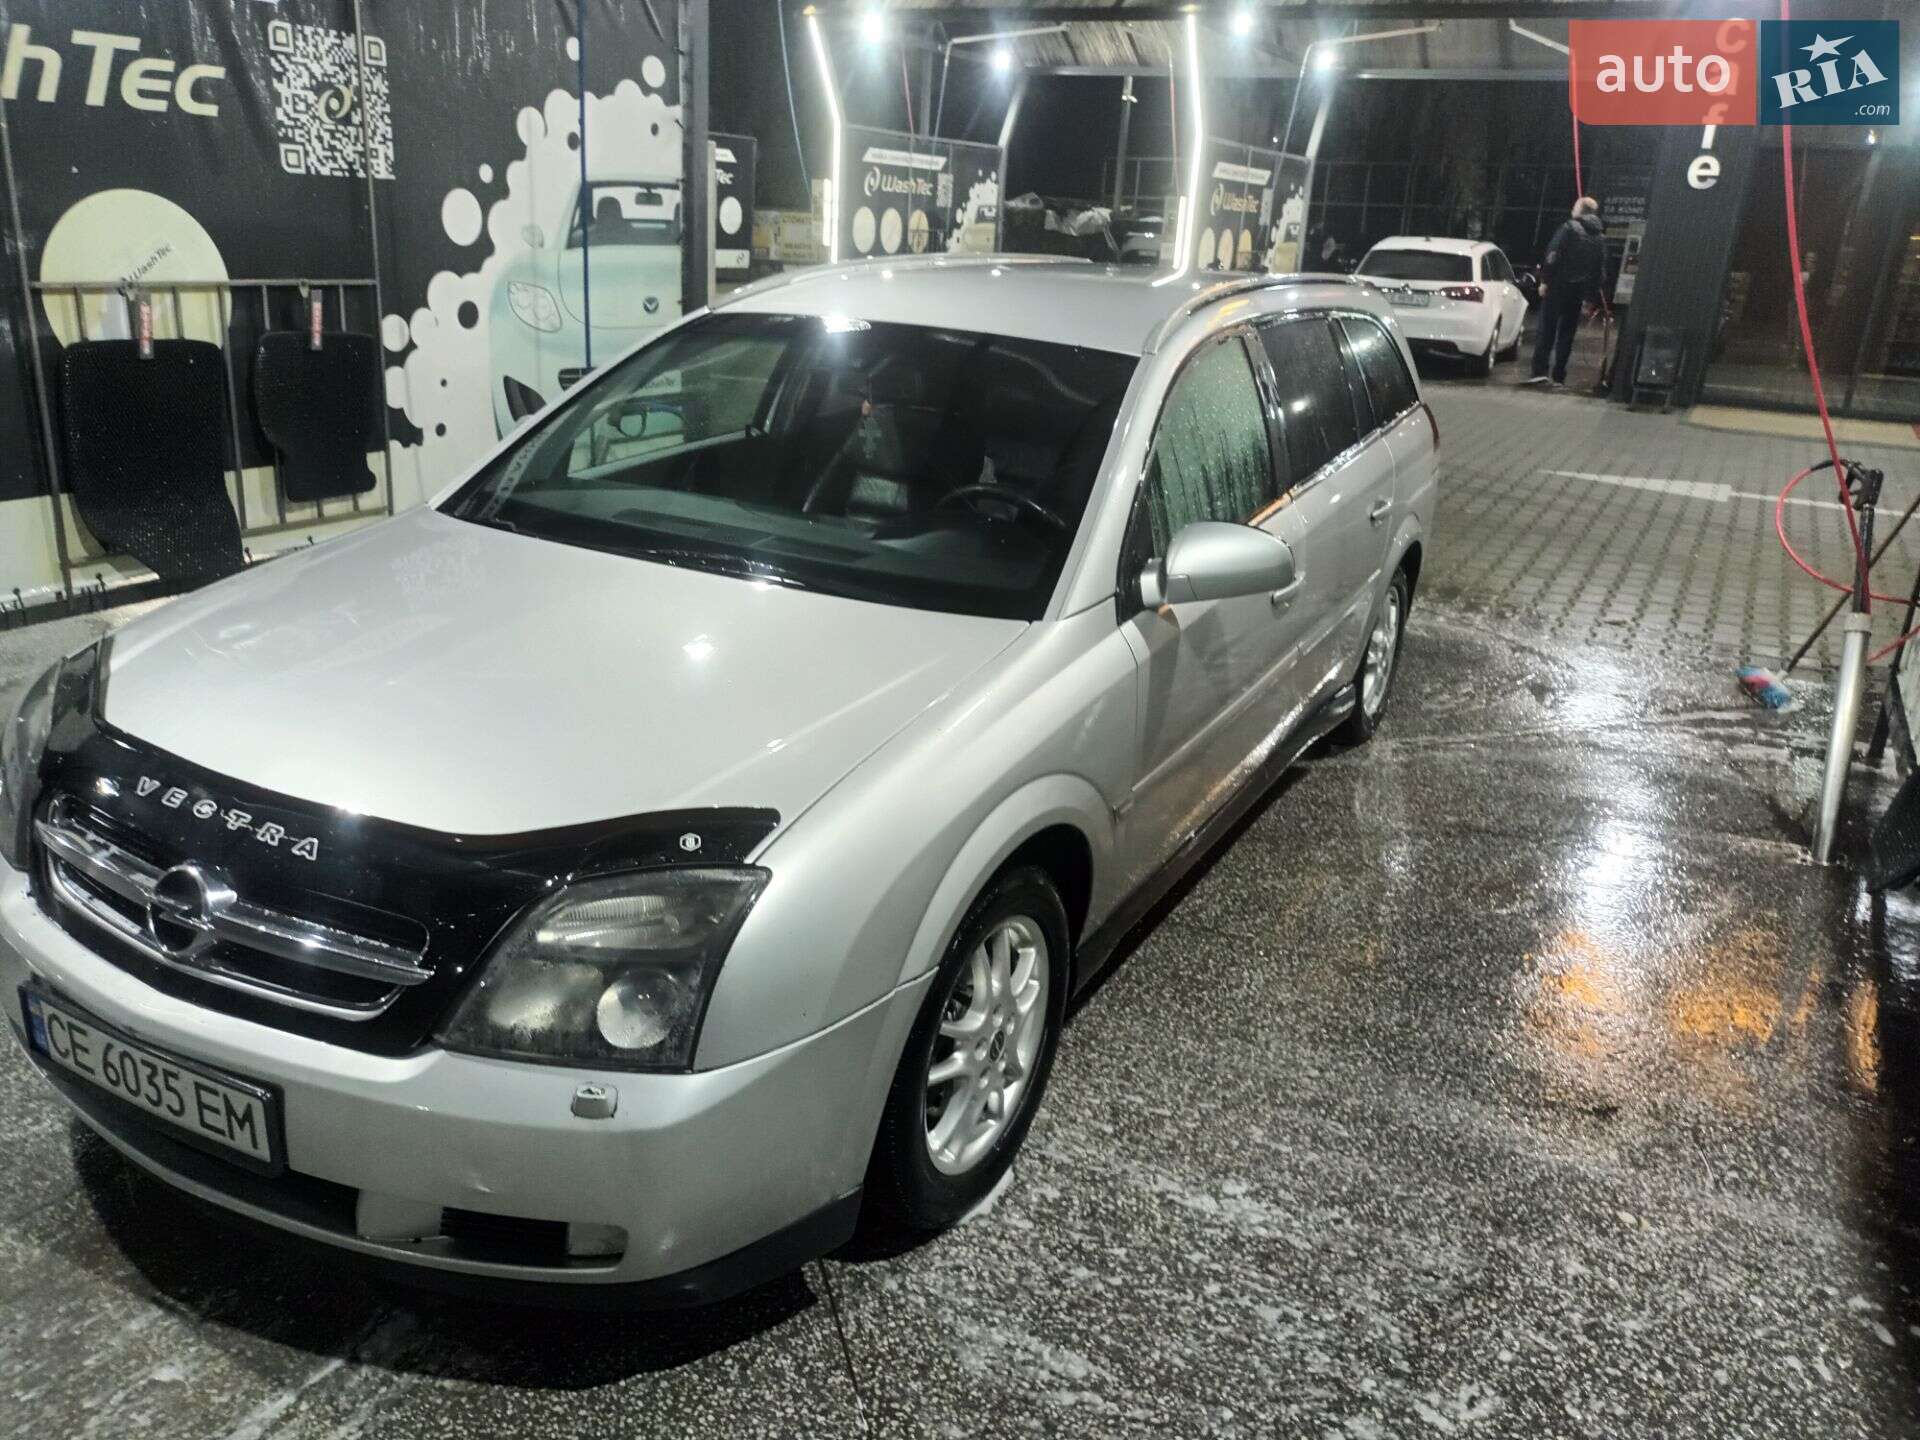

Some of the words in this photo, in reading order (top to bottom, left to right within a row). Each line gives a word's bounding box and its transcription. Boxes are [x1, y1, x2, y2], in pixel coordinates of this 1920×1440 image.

[881, 173, 933, 195] WashTec
[136, 775, 320, 861] VECTRA
[46, 1012, 96, 1077] CE
[102, 1040, 186, 1118] 6035
[194, 1081, 260, 1151] EM
